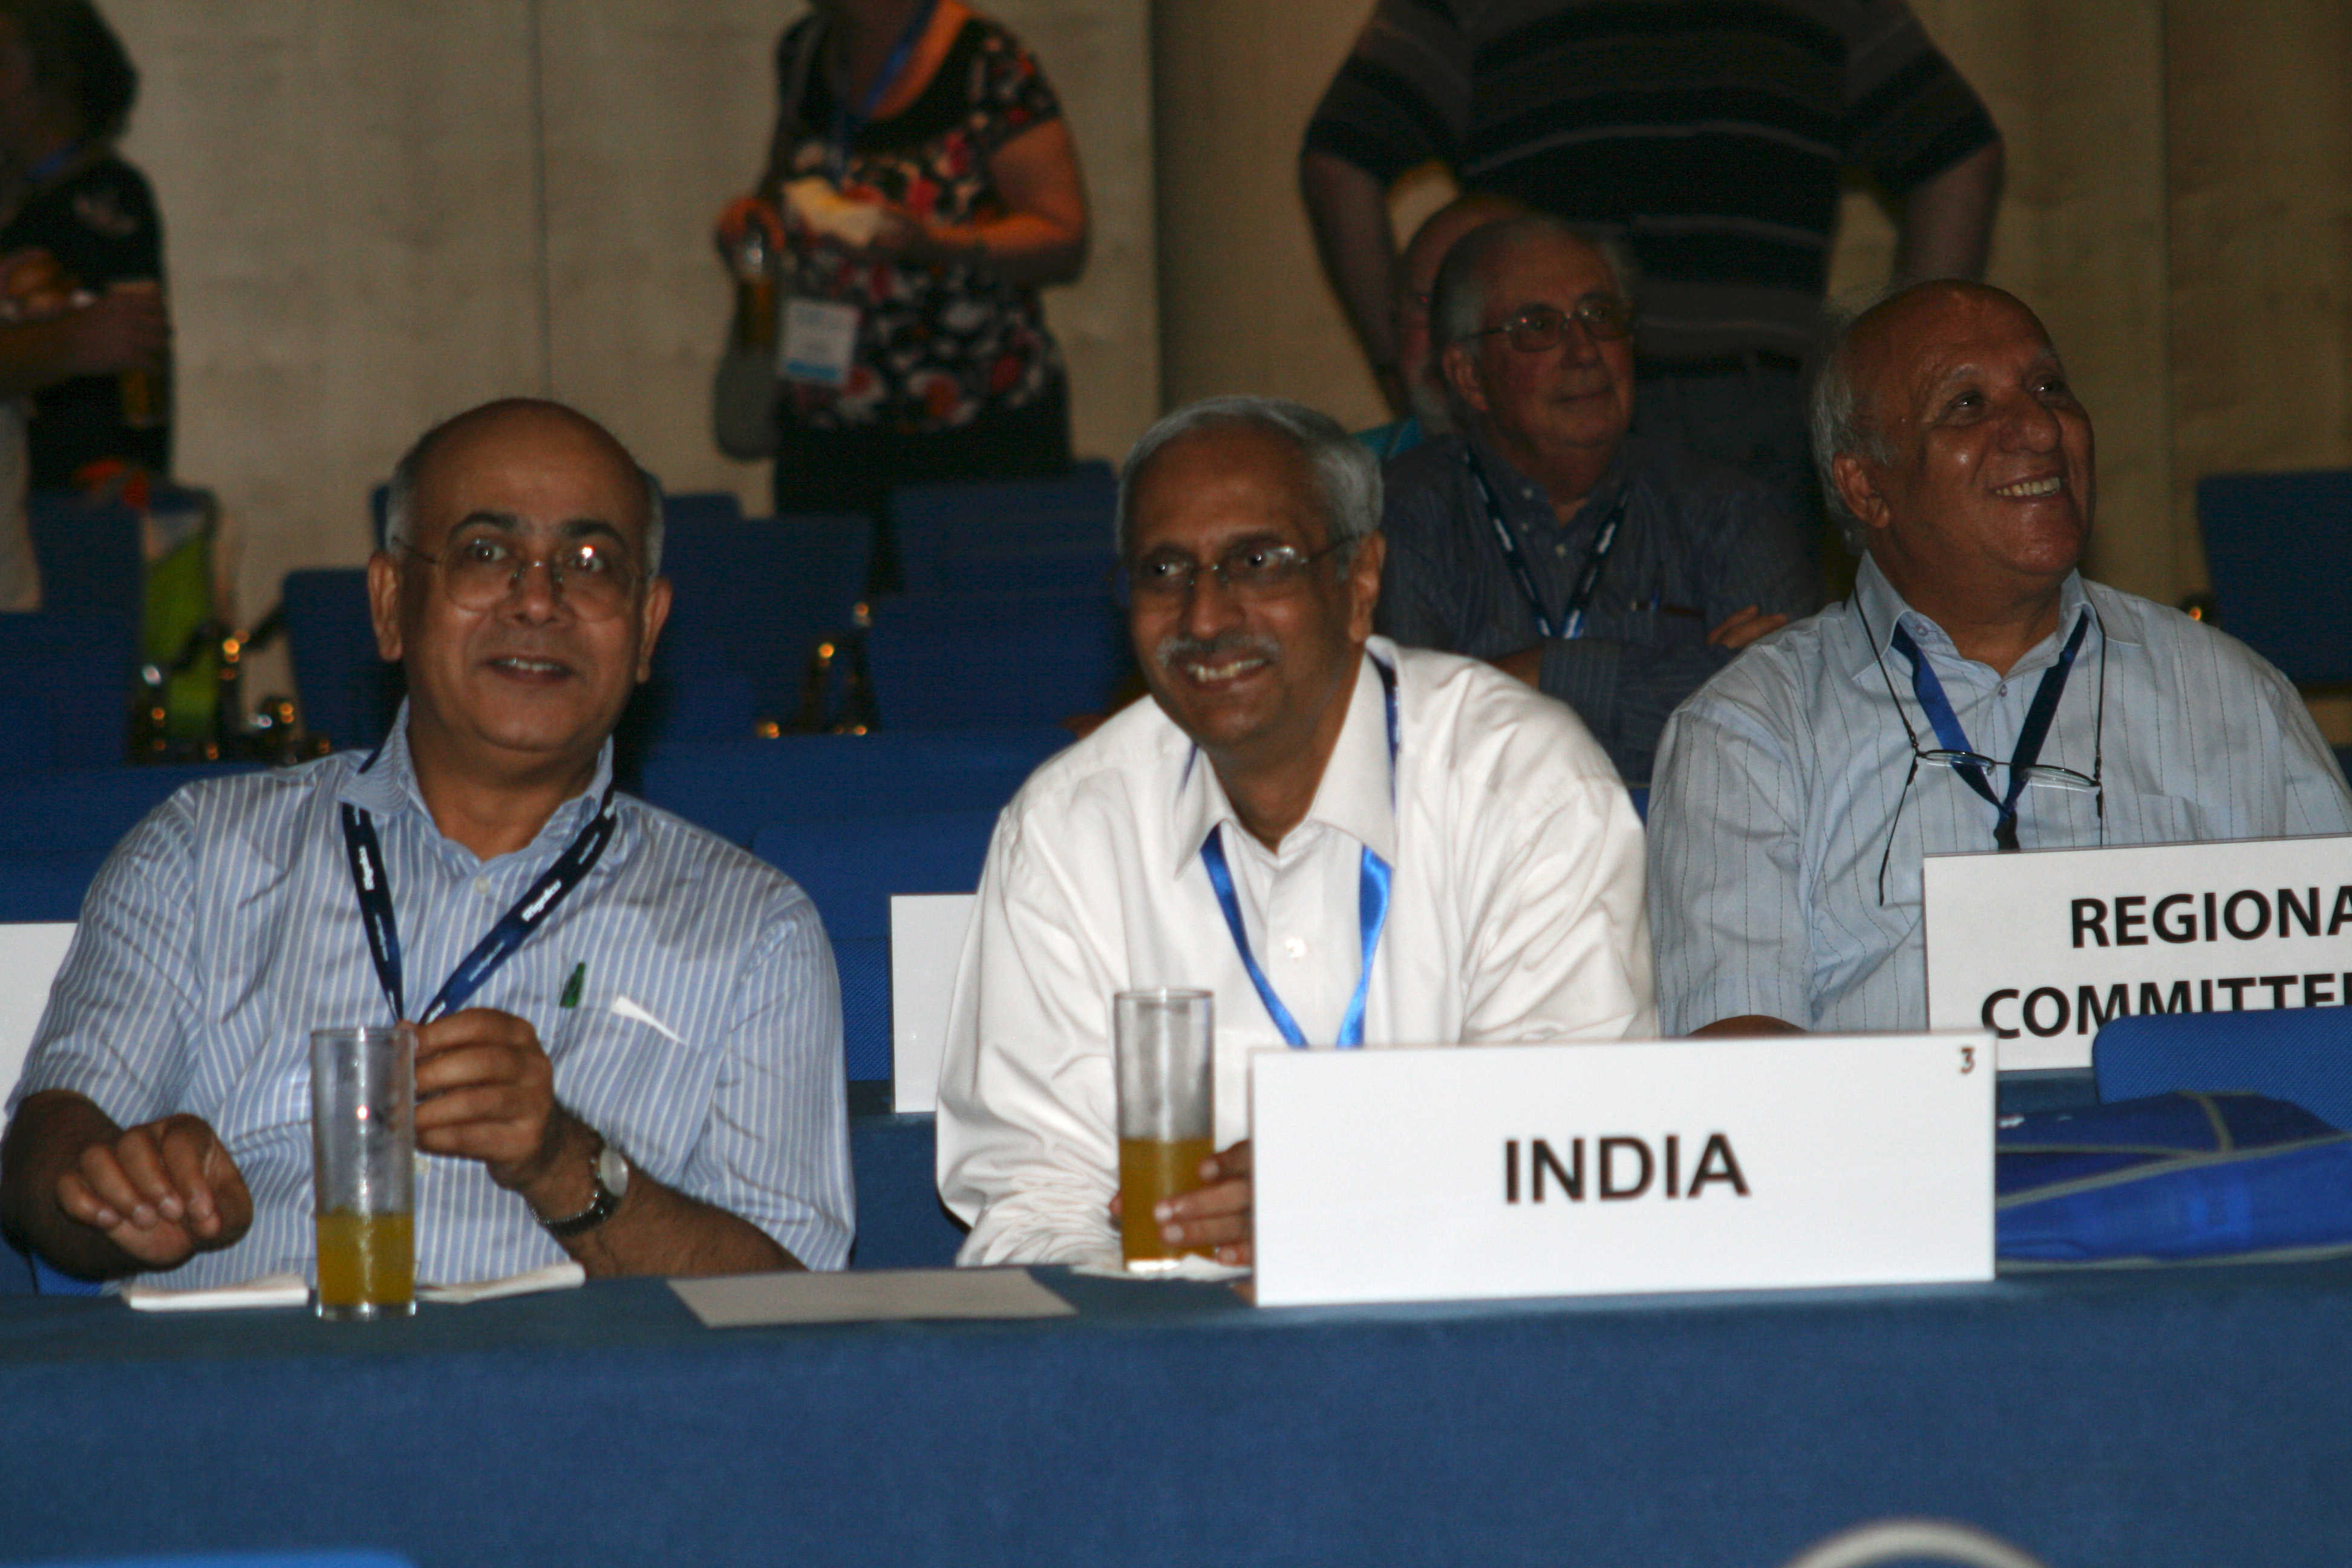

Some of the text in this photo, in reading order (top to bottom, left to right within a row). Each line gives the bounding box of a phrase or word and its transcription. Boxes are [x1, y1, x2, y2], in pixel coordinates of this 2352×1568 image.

[1981, 972, 2352, 1039] COMMITTE
[1960, 1046, 1976, 1074] 3
[1505, 1132, 1750, 1204] INDIA
